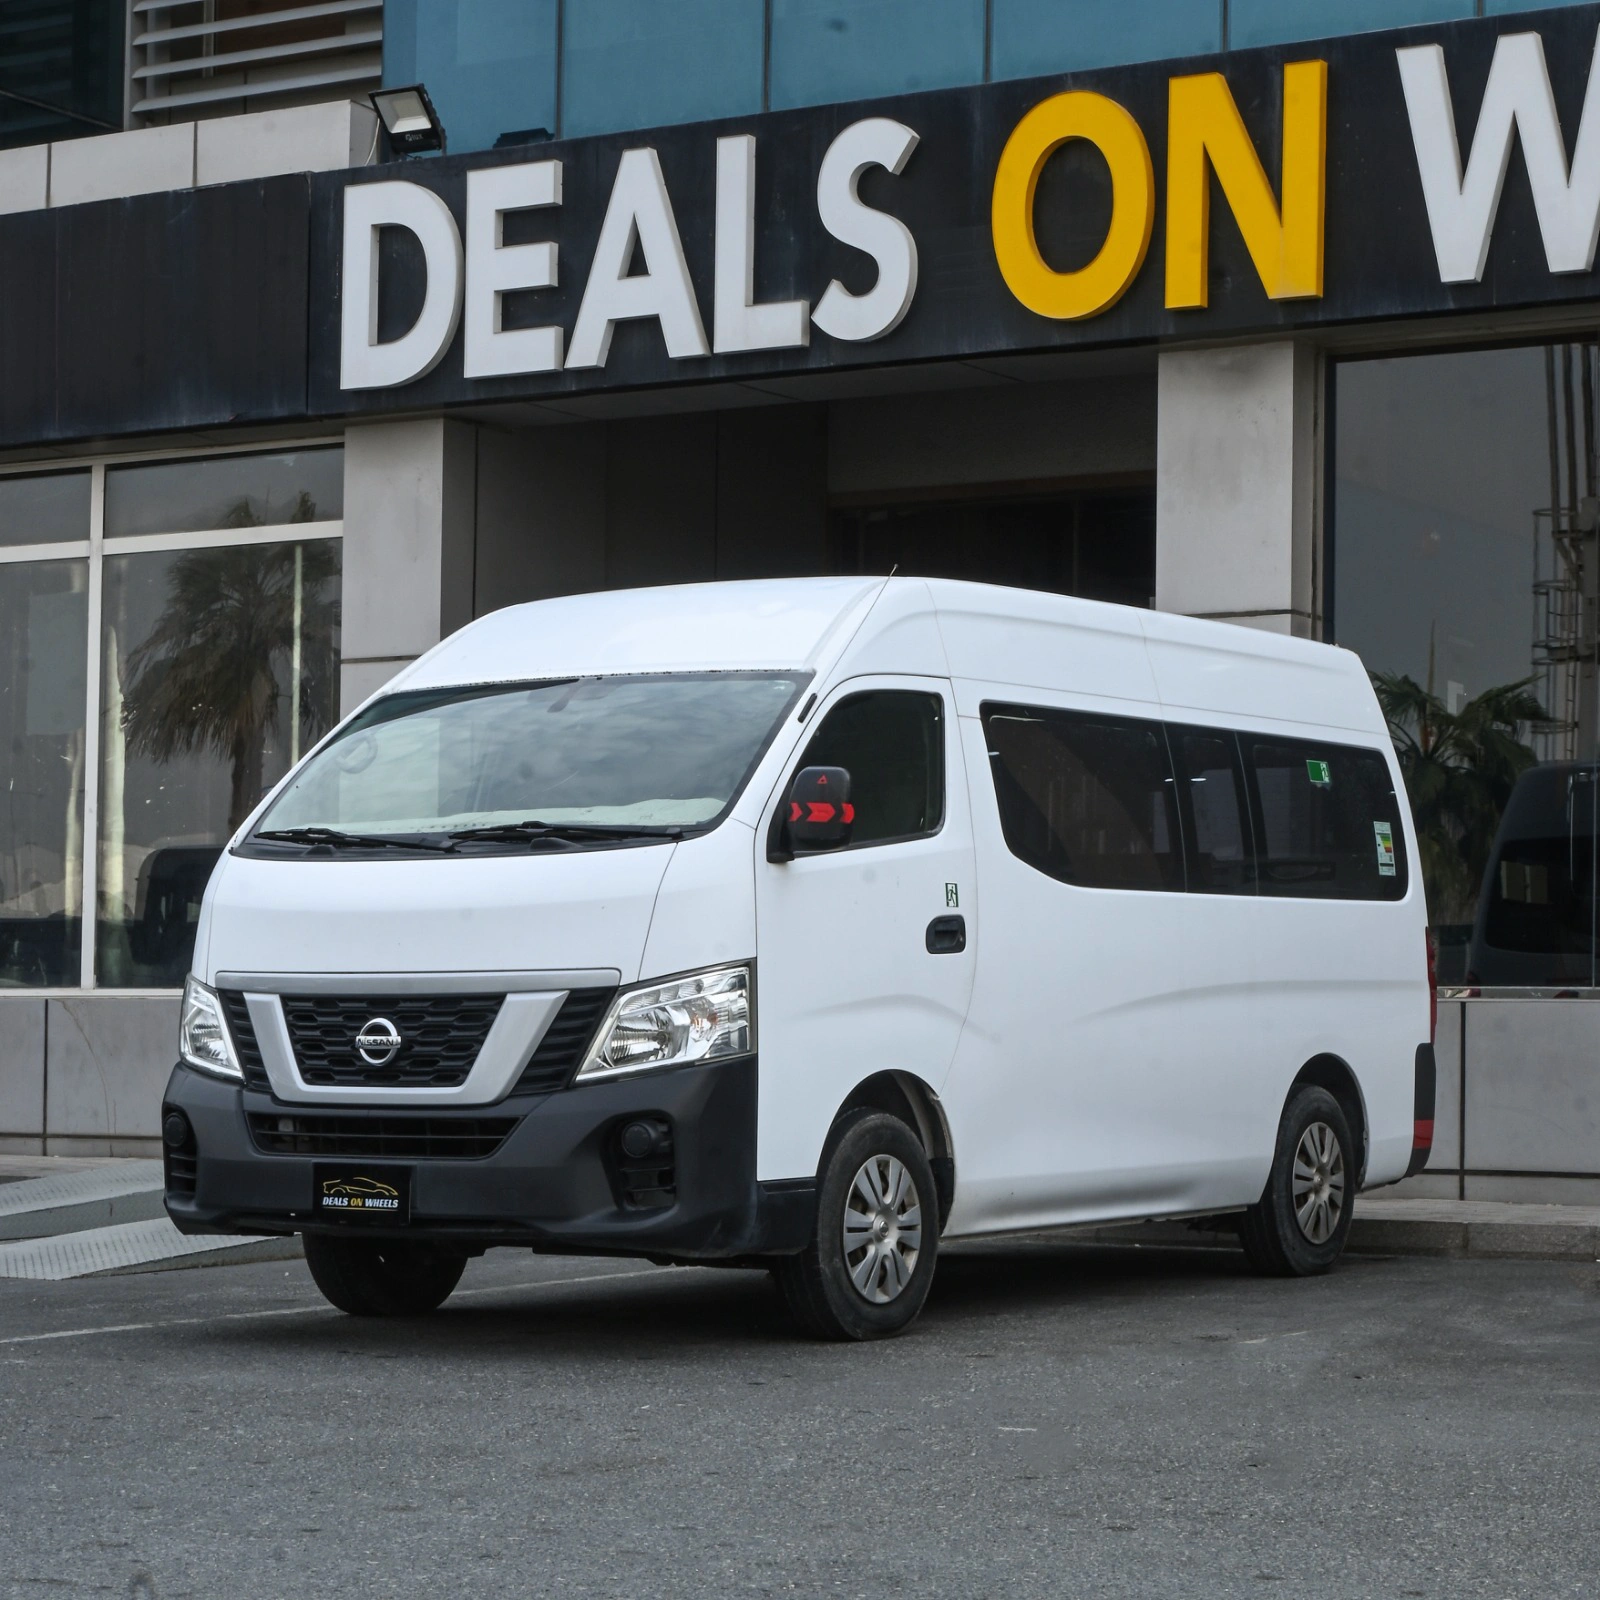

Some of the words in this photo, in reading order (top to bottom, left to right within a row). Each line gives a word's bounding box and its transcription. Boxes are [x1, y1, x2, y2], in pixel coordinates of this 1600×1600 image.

[340, 117, 920, 390] DEALS
[991, 59, 1328, 321] ON
[357, 1037, 394, 1047] NISSAN
[322, 1196, 349, 1206] DEALS
[350, 1197, 363, 1207] ON
[365, 1198, 399, 1207] WHEELS
